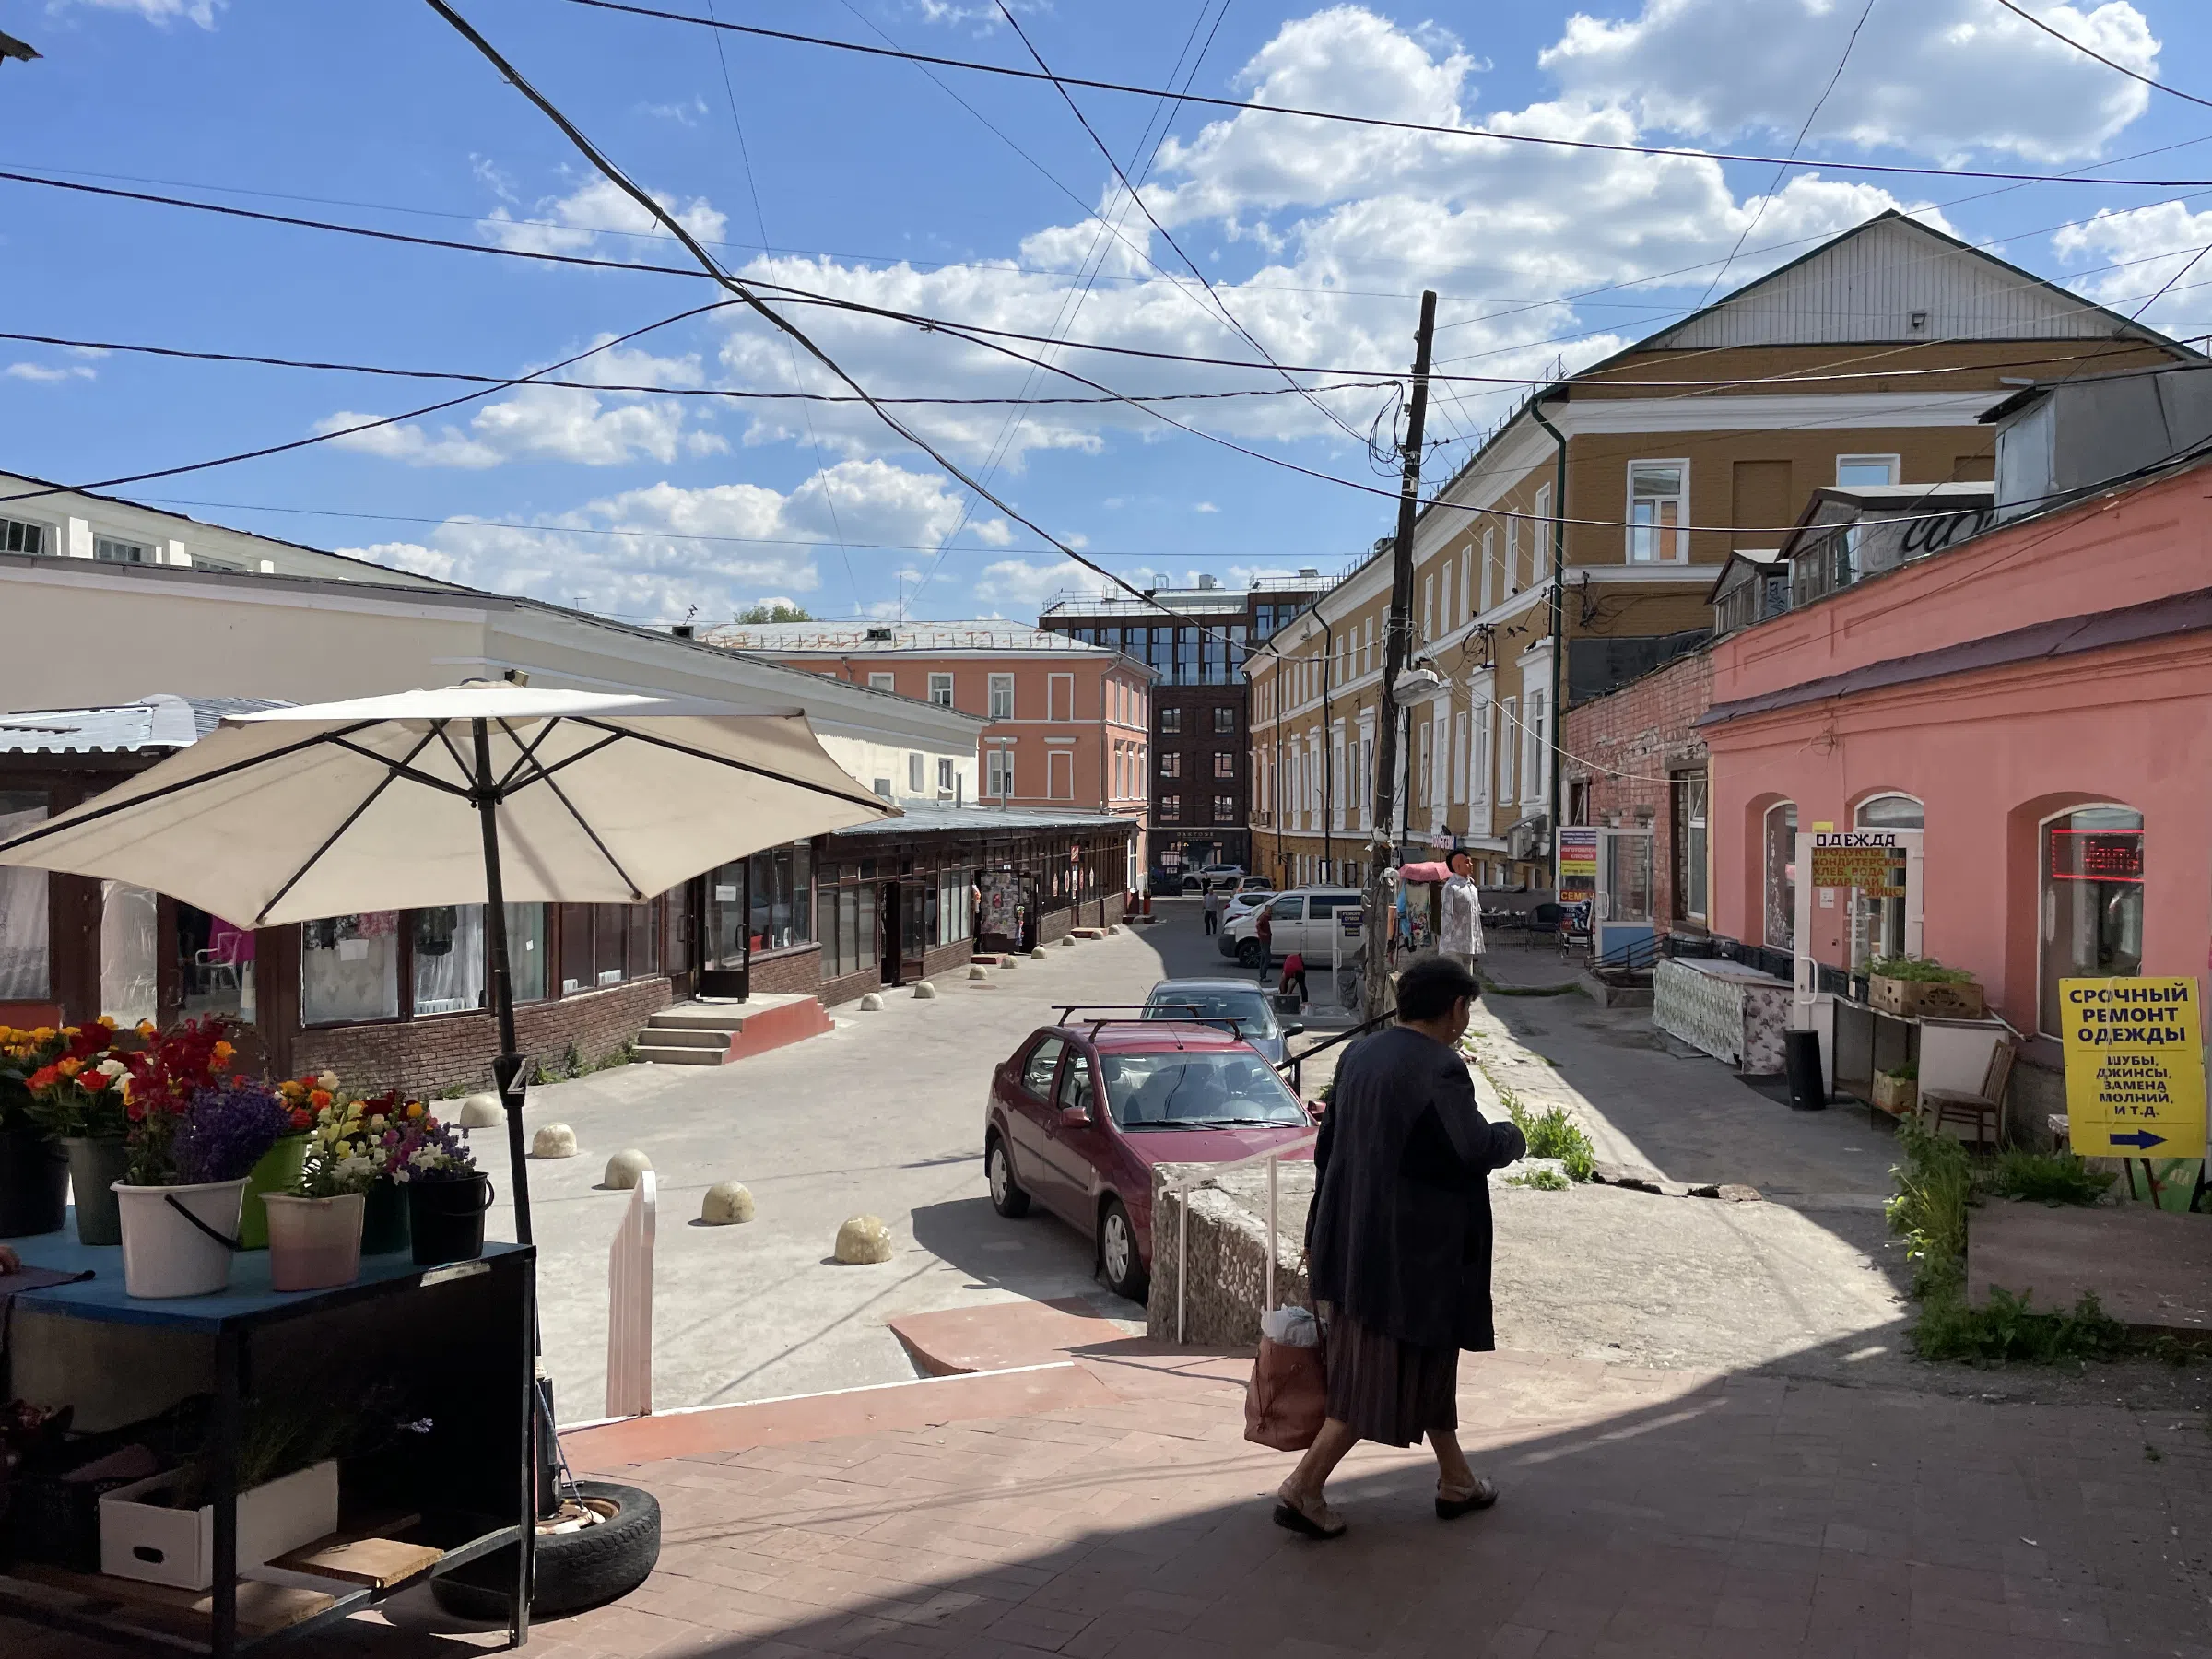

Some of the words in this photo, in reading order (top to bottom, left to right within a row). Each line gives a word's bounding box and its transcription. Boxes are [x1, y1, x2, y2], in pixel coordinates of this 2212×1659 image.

[1816, 833, 1896, 847] ОДЕЖДА
[2069, 982, 2188, 1003] СРОЧНЫЙ
[2082, 1007, 2179, 1023] РЕМОНТ
[2077, 1027, 2186, 1045] ОДЕЖДЫ
[2104, 1080, 2166, 1090] ЗАМЕНА
[2114, 1106, 2126, 1115] И
[2130, 1106, 2160, 1118] Т.Д.
